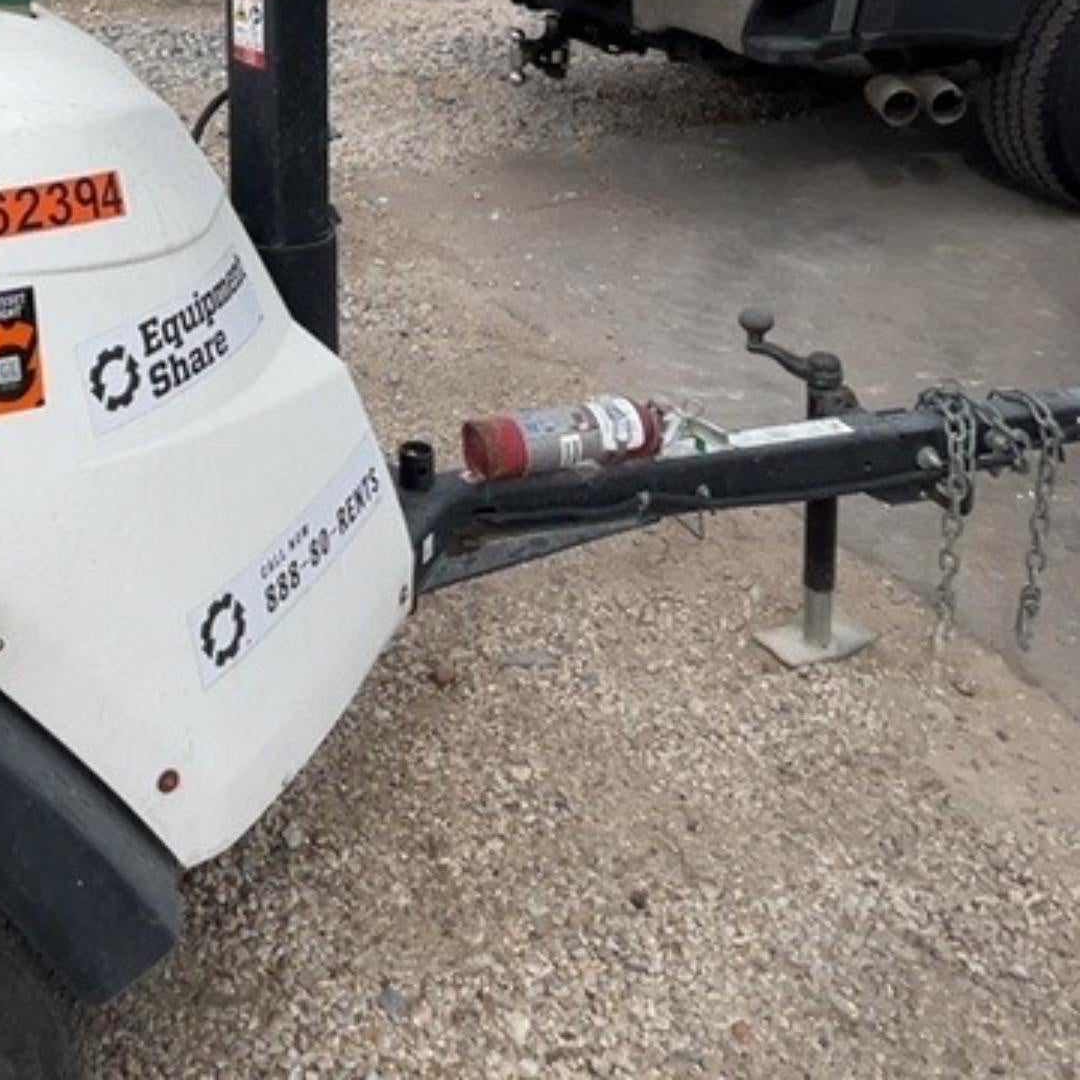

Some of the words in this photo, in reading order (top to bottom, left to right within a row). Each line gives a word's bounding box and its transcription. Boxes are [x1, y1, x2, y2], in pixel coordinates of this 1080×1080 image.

[137, 253, 247, 357] Equipment
[148, 329, 229, 399] Share
[264, 467, 379, 613] 888-80-RENTS
